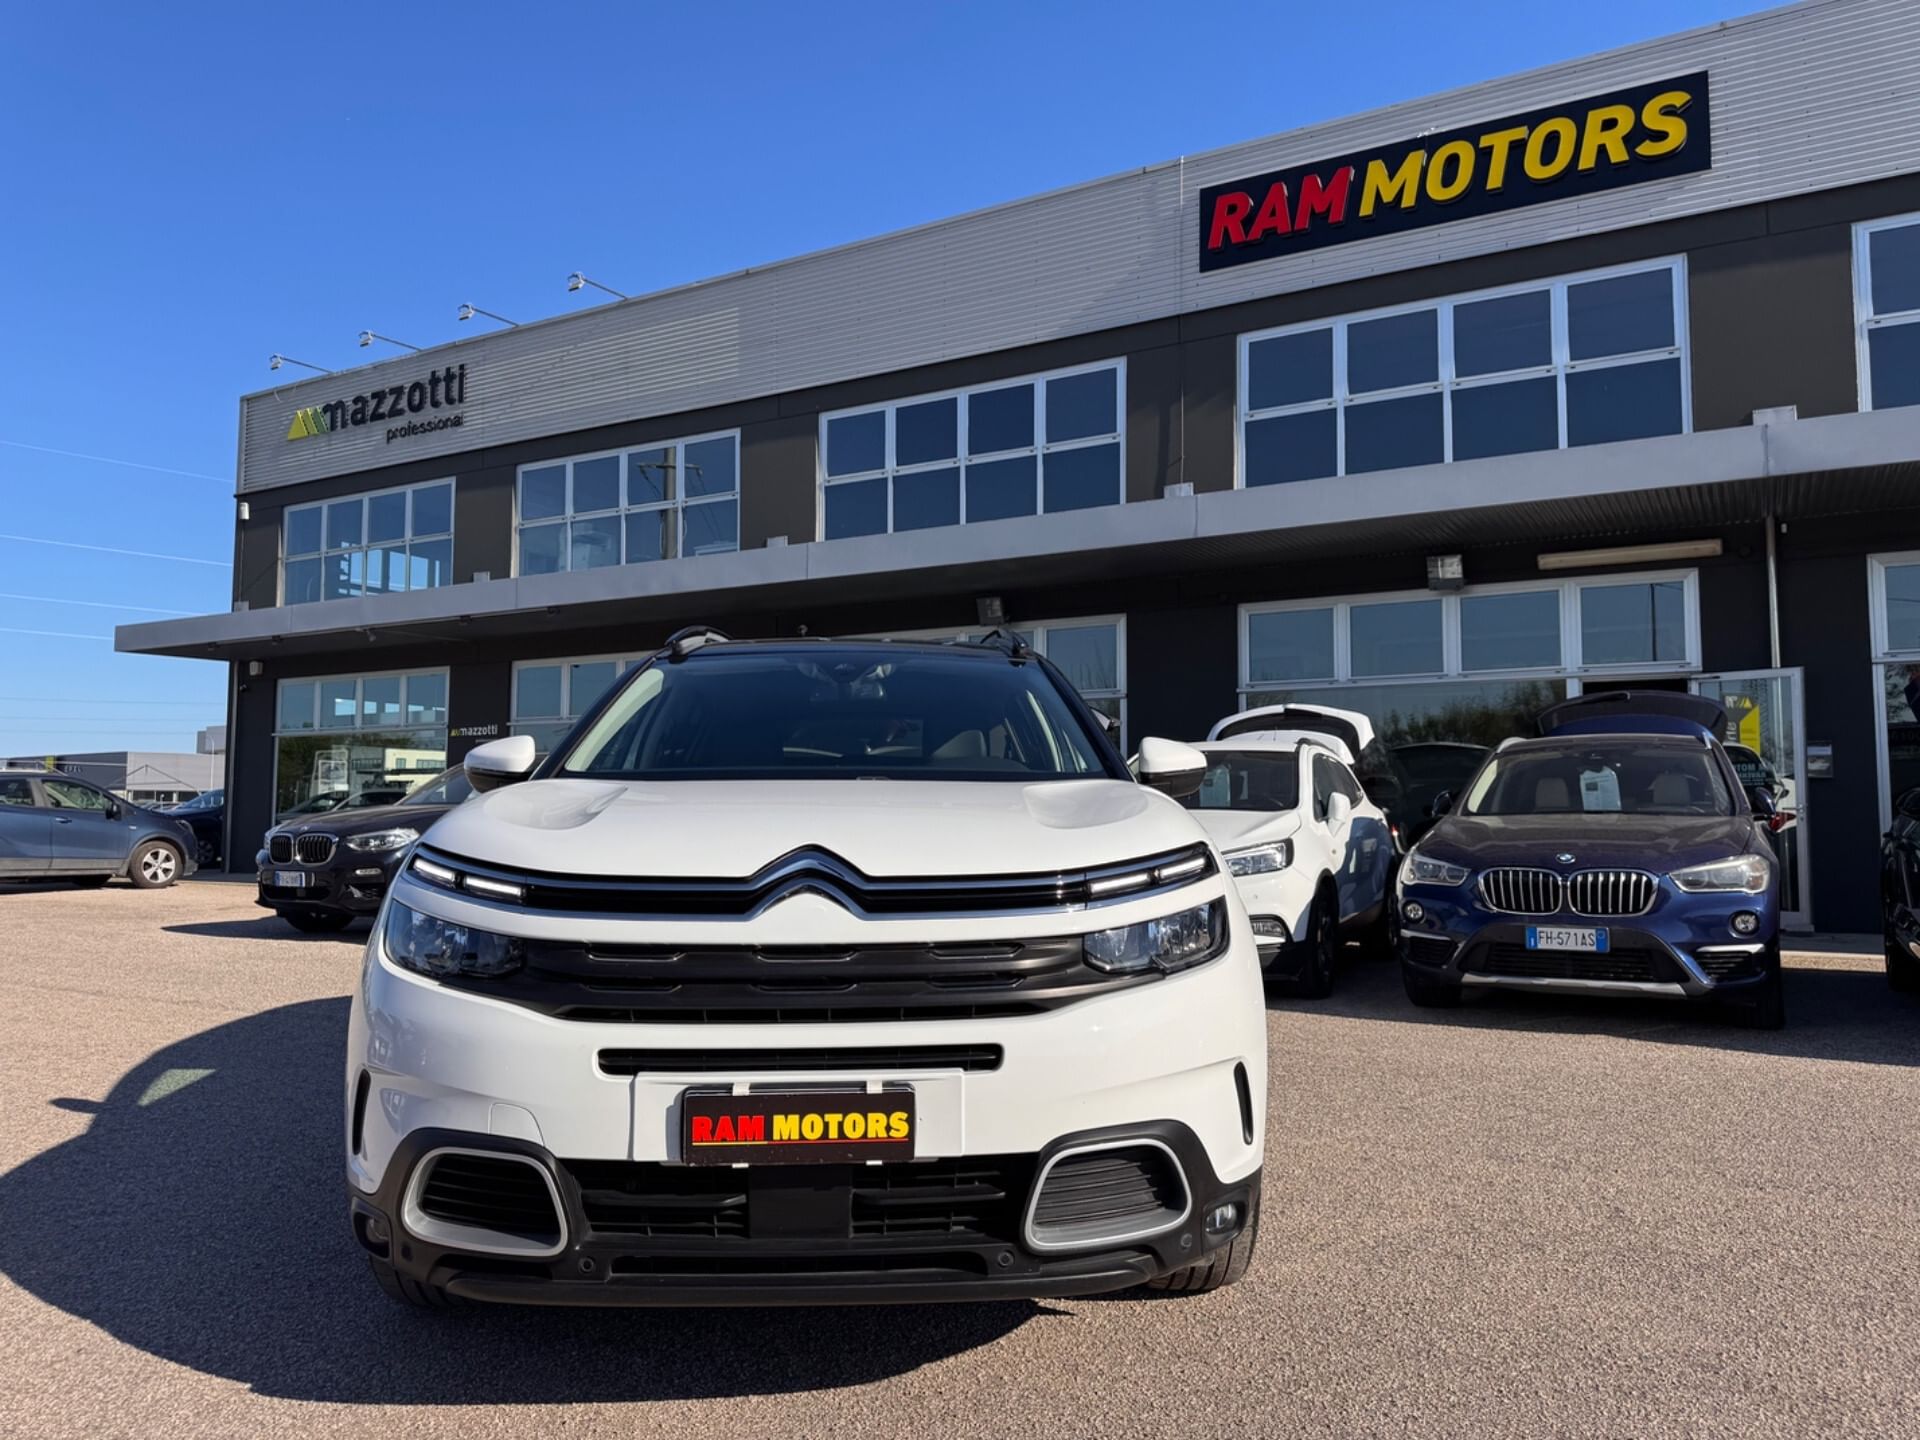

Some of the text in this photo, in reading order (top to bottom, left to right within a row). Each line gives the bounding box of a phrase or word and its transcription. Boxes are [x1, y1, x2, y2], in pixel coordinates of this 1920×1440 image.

[1208, 91, 1692, 250] RAM MOTORS
[322, 364, 466, 431] mazzotti
[460, 724, 498, 736] mazzotti
[692, 1112, 909, 1142] RAM MOTORS
